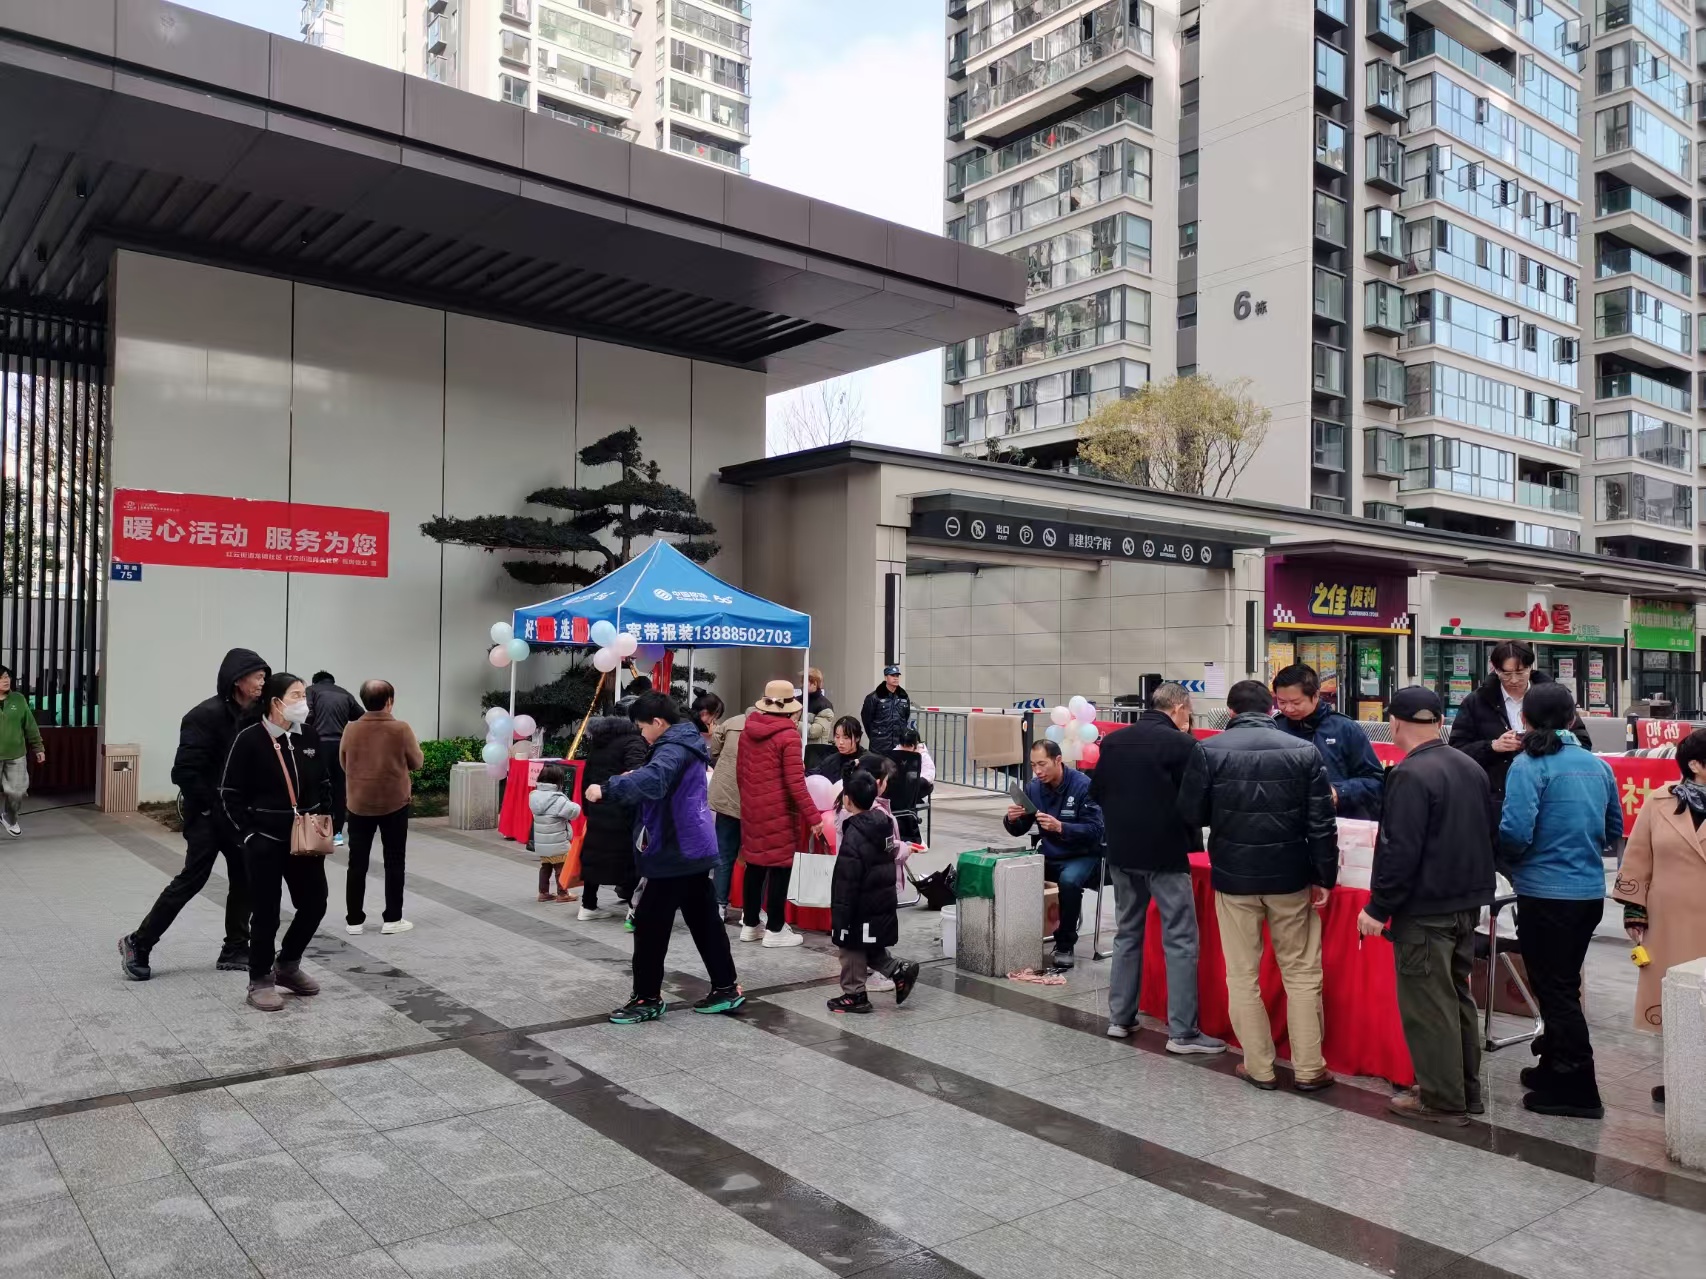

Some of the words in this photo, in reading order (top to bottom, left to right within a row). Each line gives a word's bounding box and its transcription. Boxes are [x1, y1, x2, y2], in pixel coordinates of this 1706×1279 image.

[996, 524, 1009, 534] 出口
[123, 516, 248, 547] 暖心活动
[265, 527, 377, 555] 服务为您
[1163, 544, 1174, 552] 入口
[120, 571, 133, 579] 75
